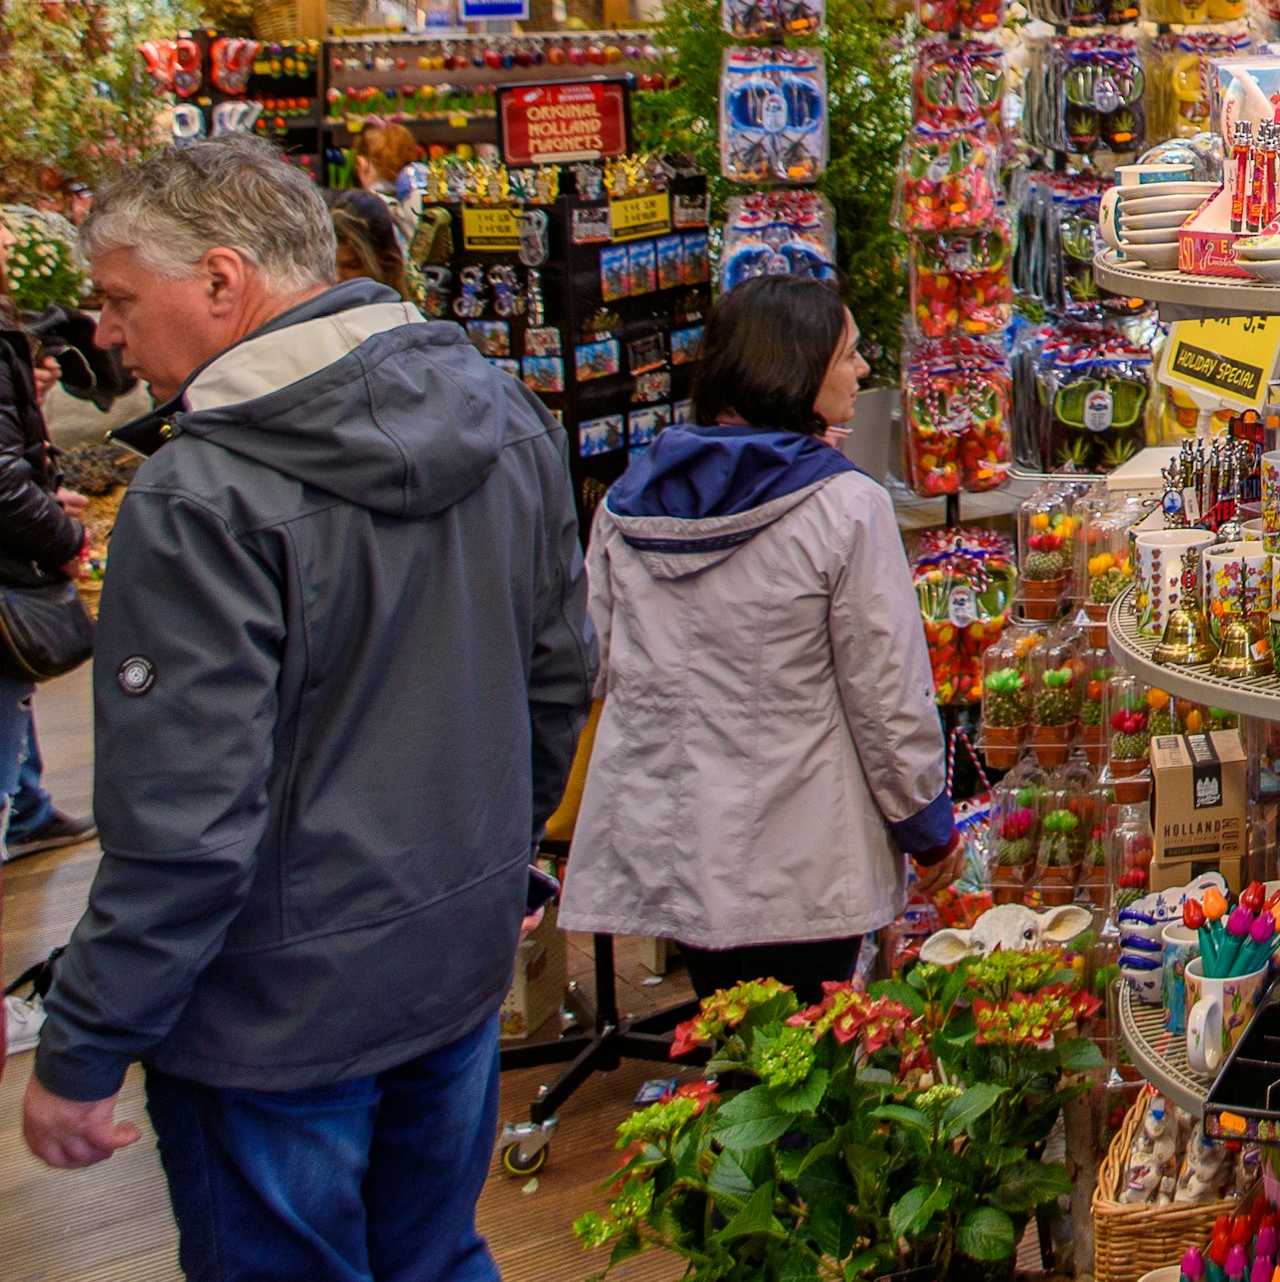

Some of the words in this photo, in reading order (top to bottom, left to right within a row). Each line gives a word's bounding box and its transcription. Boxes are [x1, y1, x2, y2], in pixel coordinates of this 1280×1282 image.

[526, 103, 602, 121] ORIGINAL
[528, 118, 602, 138] HOLLAND
[528, 134, 604, 154] MAGNETS
[1177, 348, 1218, 378] HOLIDAY
[1215, 362, 1255, 390] SPECIAL
[1163, 819, 1221, 838] HOLLAND
[1222, 818, 1240, 852] MUG
